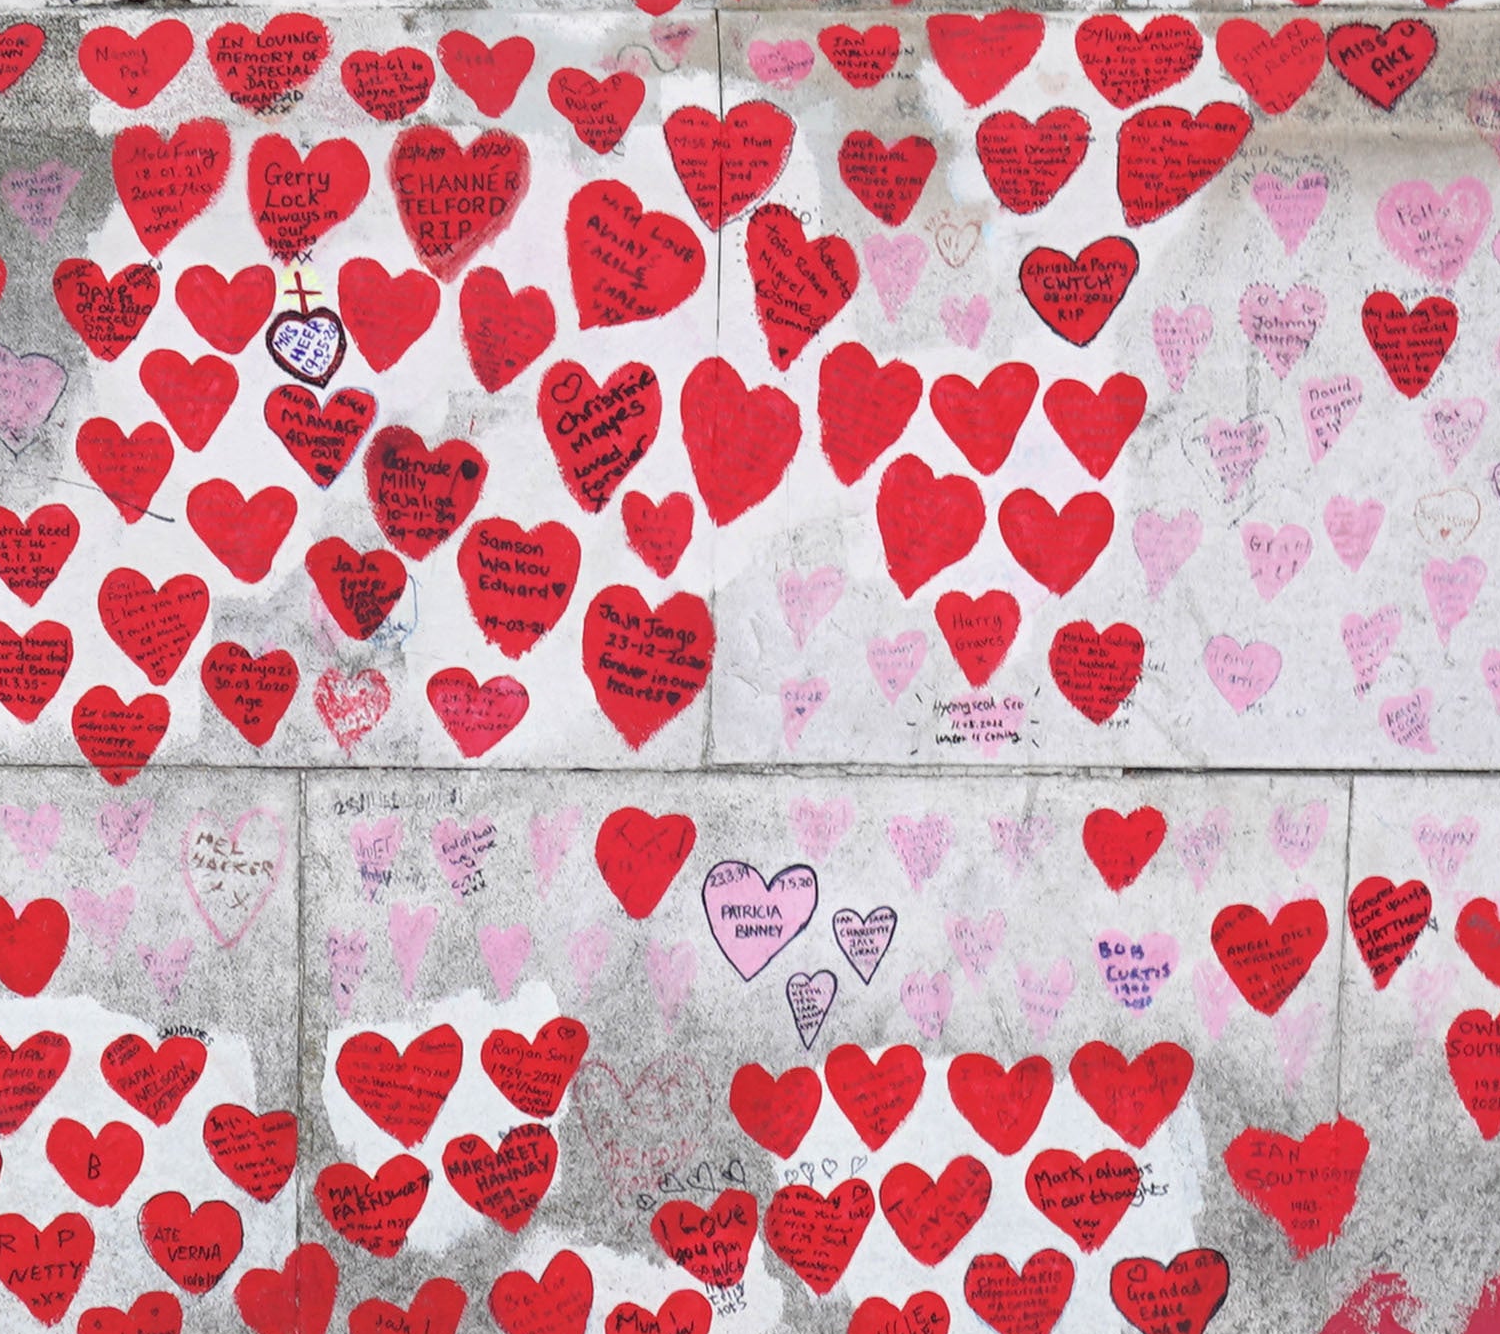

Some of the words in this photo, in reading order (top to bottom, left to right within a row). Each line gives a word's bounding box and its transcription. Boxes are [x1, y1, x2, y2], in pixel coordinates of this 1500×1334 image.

[221, 37, 243, 48] IN
[256, 31, 319, 48] LOVING
[216, 51, 293, 64] MEMORY
[302, 50, 318, 62] OF
[1371, 49, 1413, 75] AKI
[246, 65, 312, 77] SPECIAL
[230, 90, 305, 105] GRANDAD
[263, 162, 331, 192] Gerry
[265, 189, 320, 208] Lock
[401, 197, 505, 215] TELFORD
[259, 210, 319, 226] Always
[420, 219, 472, 239] RIP
[273, 324, 299, 351] MRS
[289, 319, 322, 362] HEER
[479, 530, 543, 555] Samson
[479, 576, 547, 598] Edward
[720, 905, 782, 919] PATRICIA
[735, 924, 782, 937] BINNEY
[88, 1152, 100, 1180] B
[448, 1142, 539, 1179] MARGARET
[1096, 1163, 1153, 1183] always
[1061, 1194, 1085, 1208] our
[1089, 1182, 1170, 1207] thoughts
[167, 1246, 221, 1262] VERNA
[7, 1262, 82, 1284] NETTY
